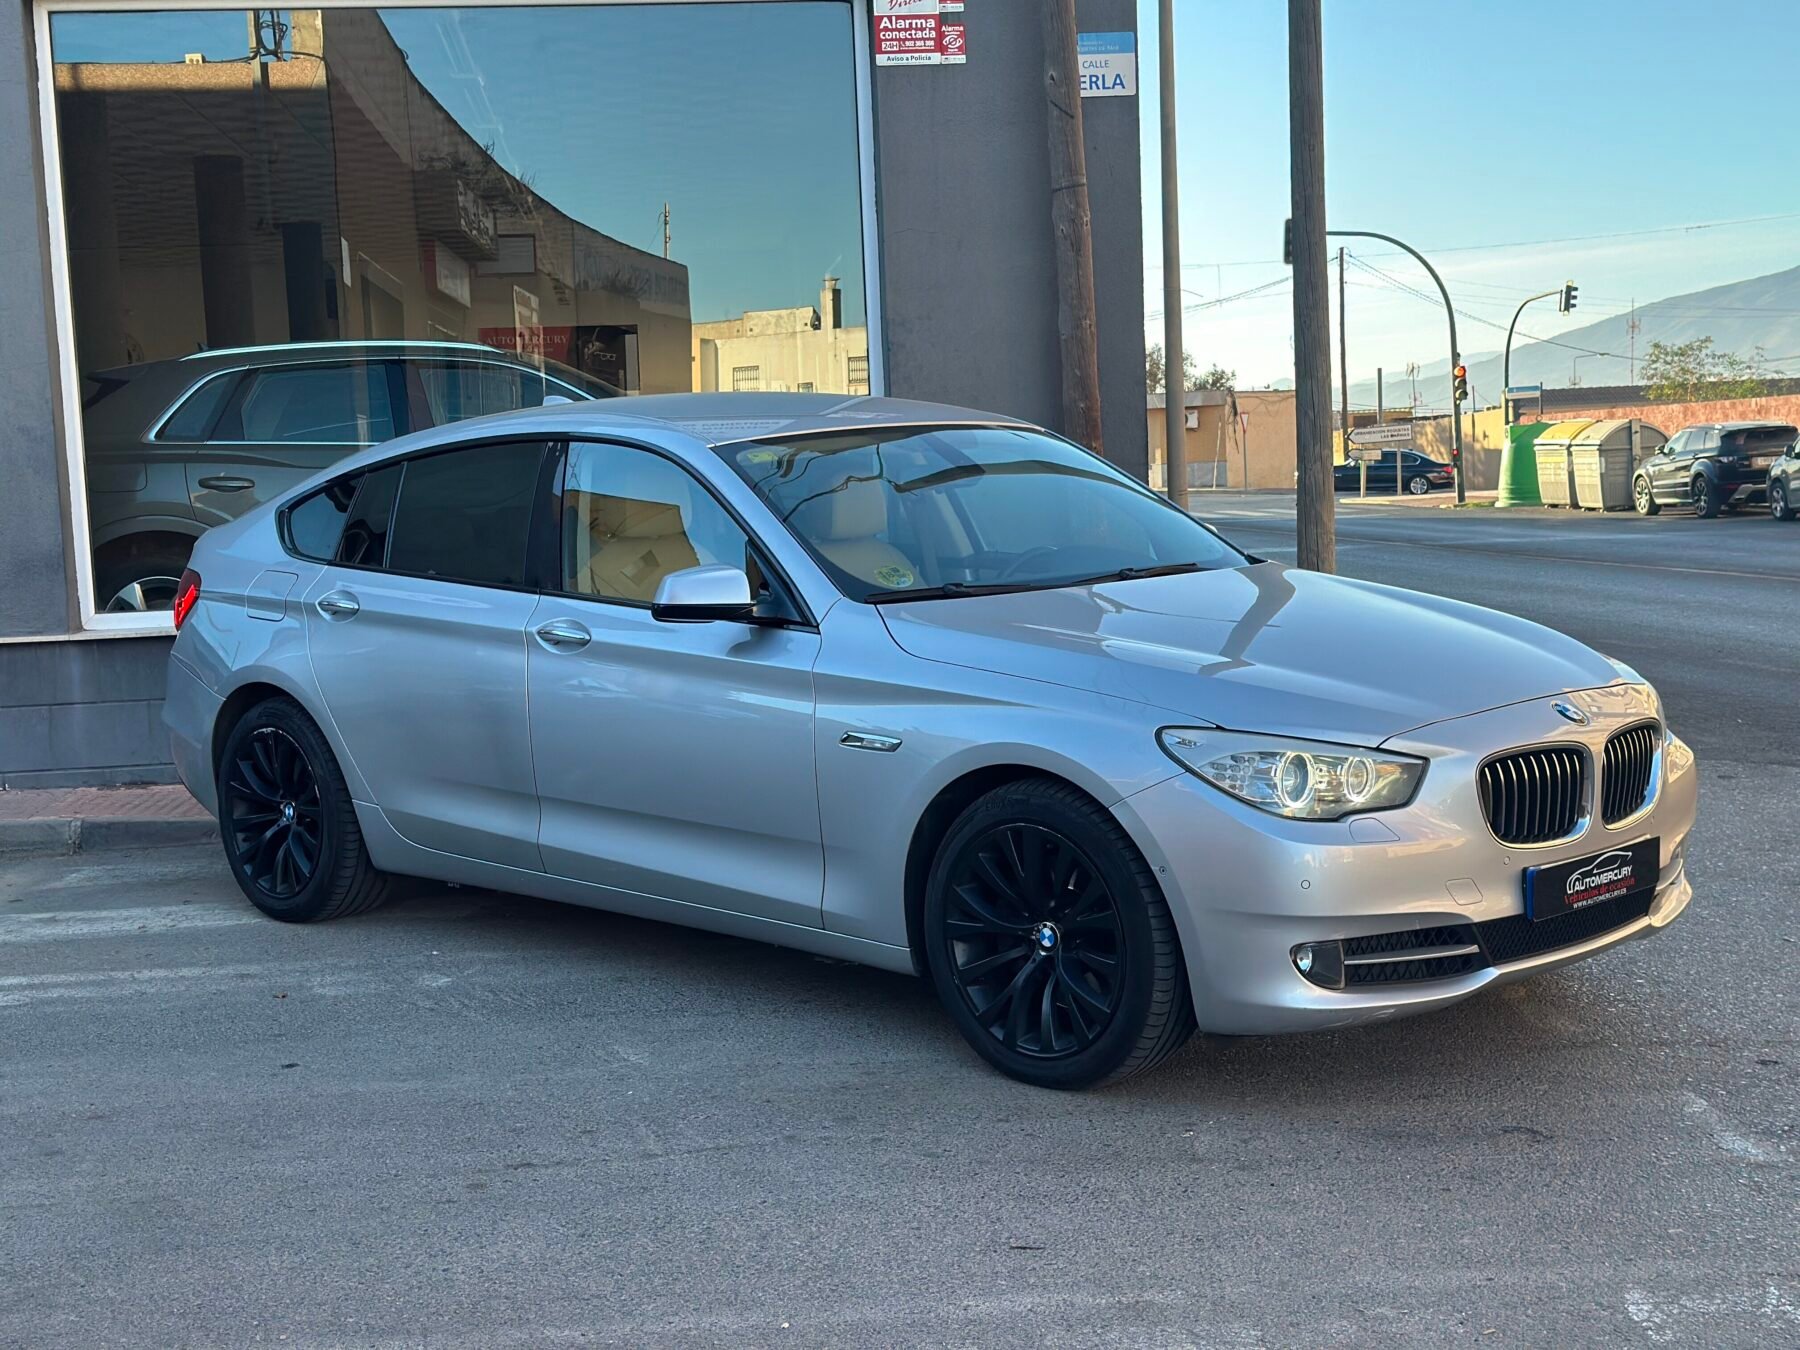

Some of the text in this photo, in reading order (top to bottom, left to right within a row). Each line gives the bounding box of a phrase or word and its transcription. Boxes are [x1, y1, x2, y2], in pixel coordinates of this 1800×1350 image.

[880, 15, 935, 29] Alarma
[880, 28, 936, 39] conectada
[883, 42, 898, 50] 24H
[1082, 60, 1110, 69] CALLE
[1574, 865, 1633, 892] AUTOMERCURY
